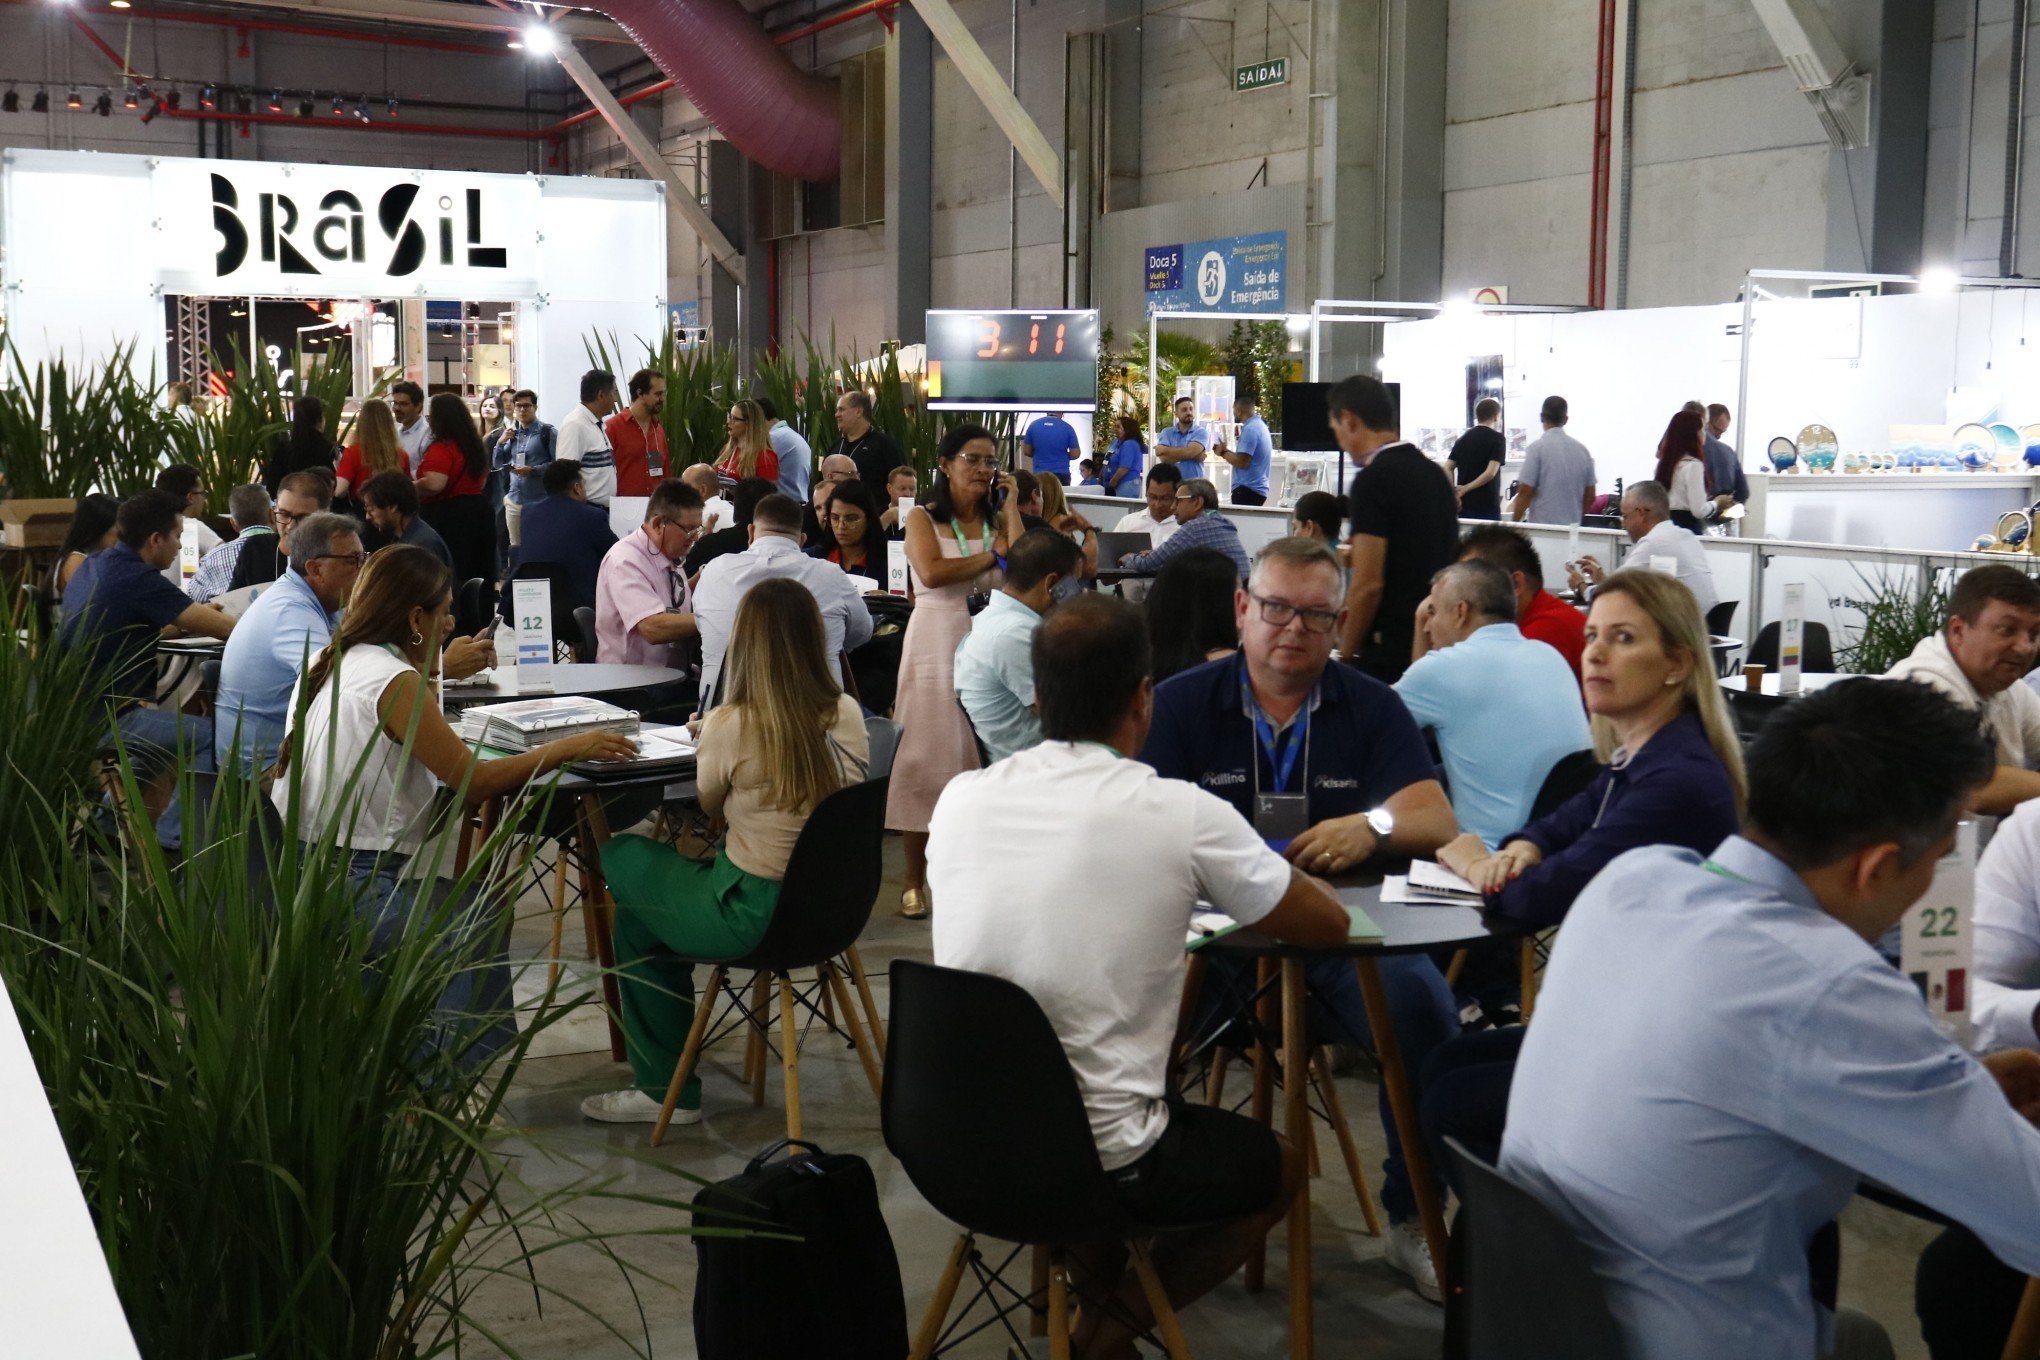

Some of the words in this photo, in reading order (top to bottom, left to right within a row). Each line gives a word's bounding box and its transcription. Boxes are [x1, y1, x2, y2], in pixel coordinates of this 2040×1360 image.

[1239, 65, 1276, 85] SAÍDA
[1149, 255, 1169, 268] Doca
[1171, 253, 1177, 267] 5
[1244, 270, 1266, 286] Saída
[1268, 268, 1279, 282] de
[1231, 287, 1279, 305] Emergência
[977, 319, 1001, 358] 3
[183, 547, 194, 556] 05
[891, 568, 903, 579] 09
[522, 616, 543, 630] 12
[1919, 906, 1958, 938] 22
